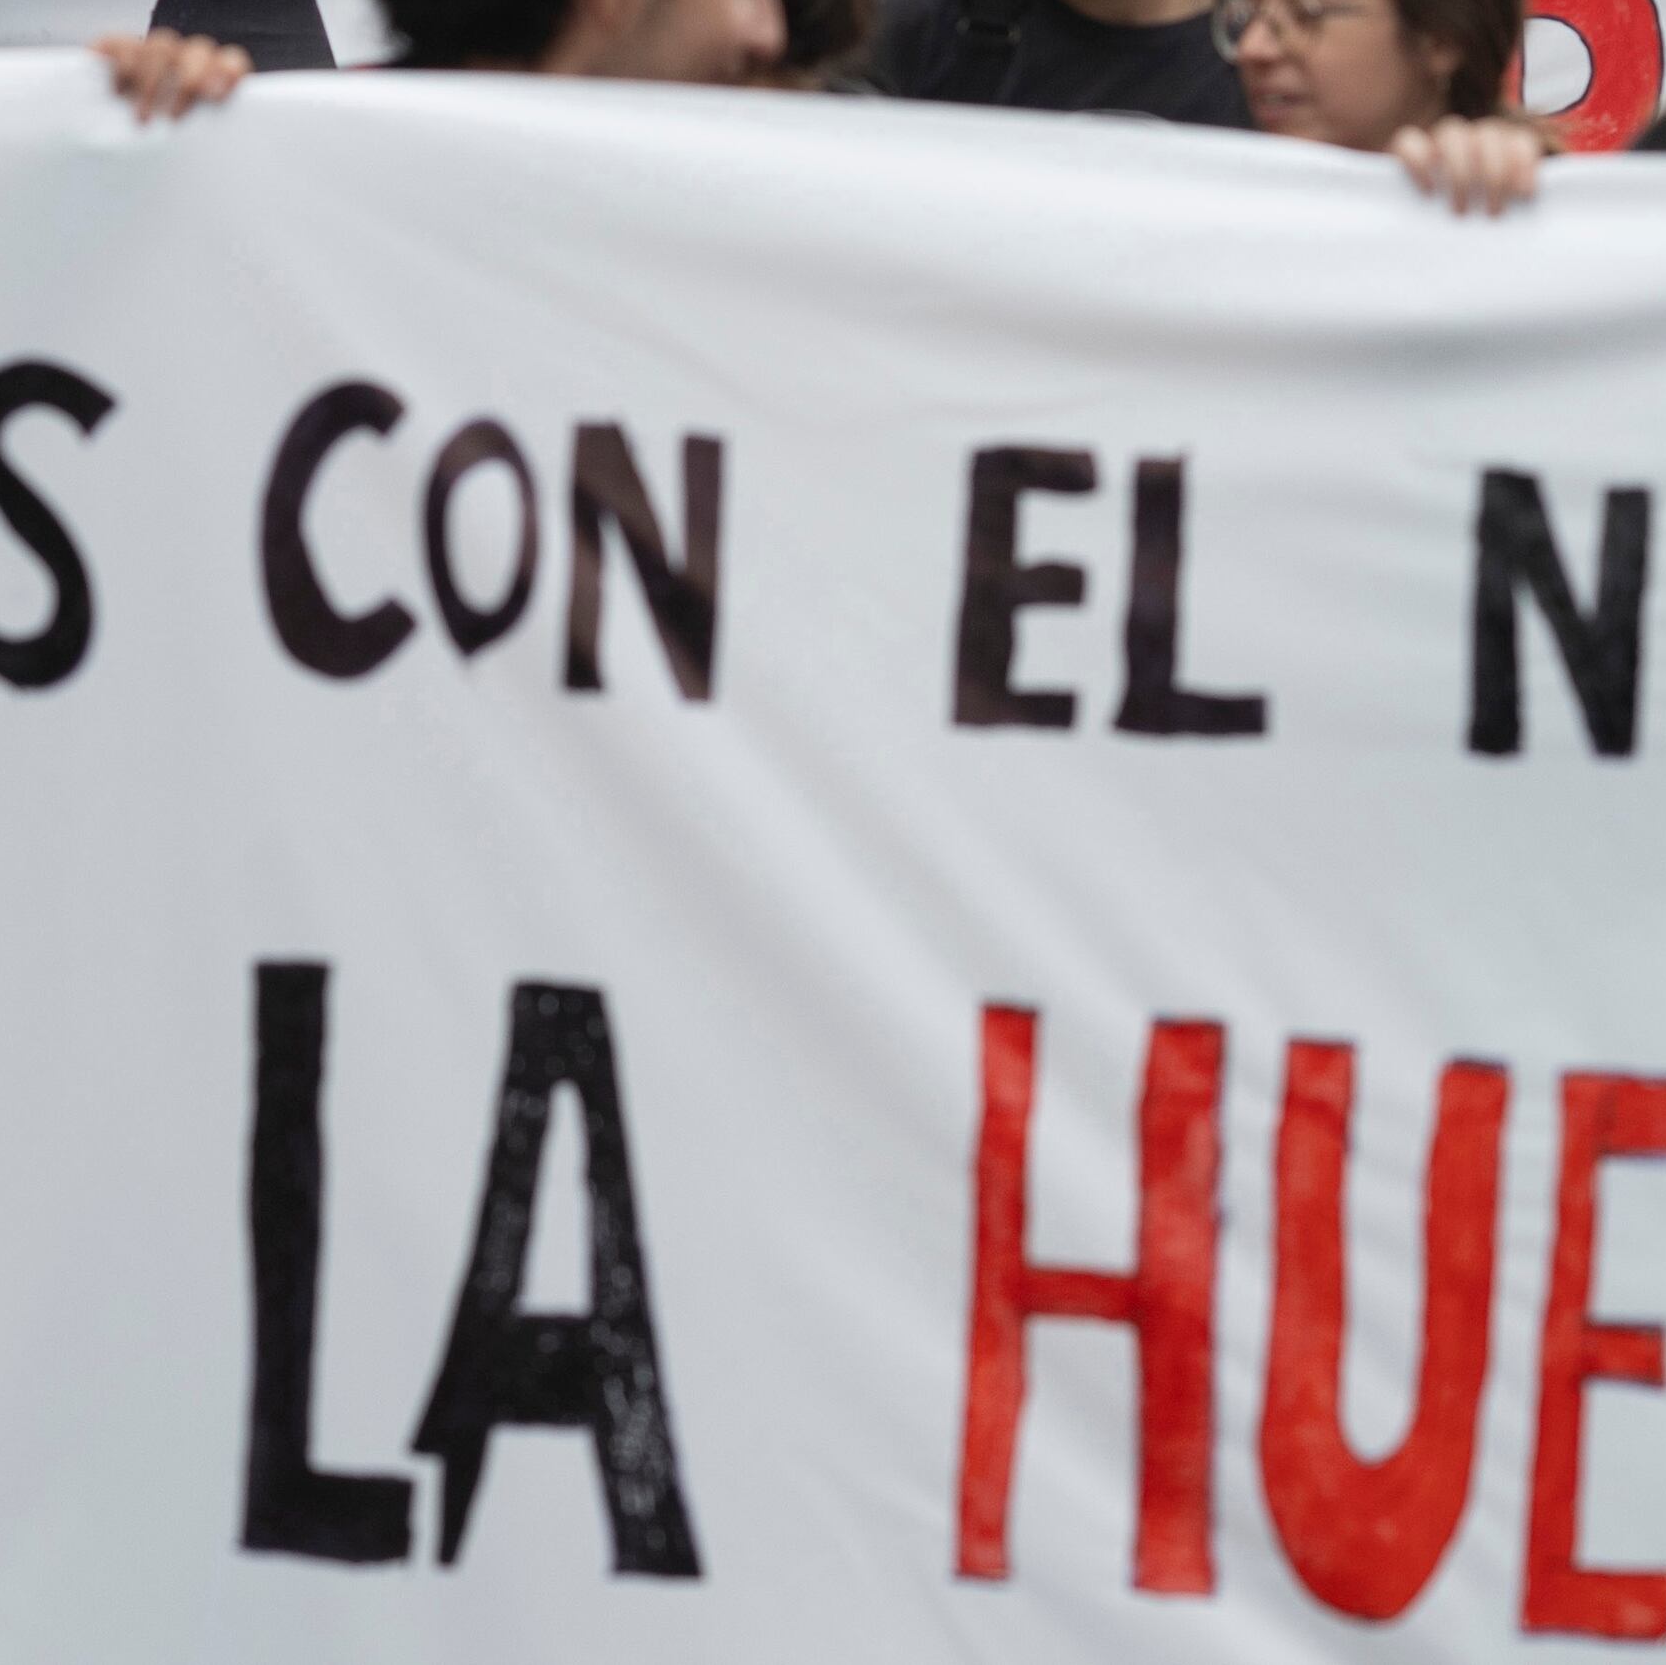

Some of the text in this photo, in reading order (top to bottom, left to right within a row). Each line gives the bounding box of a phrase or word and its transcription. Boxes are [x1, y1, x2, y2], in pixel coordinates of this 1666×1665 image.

[258, 379, 726, 704] CON
[948, 445, 1270, 736] EL
[237, 959, 707, 1580] LA
